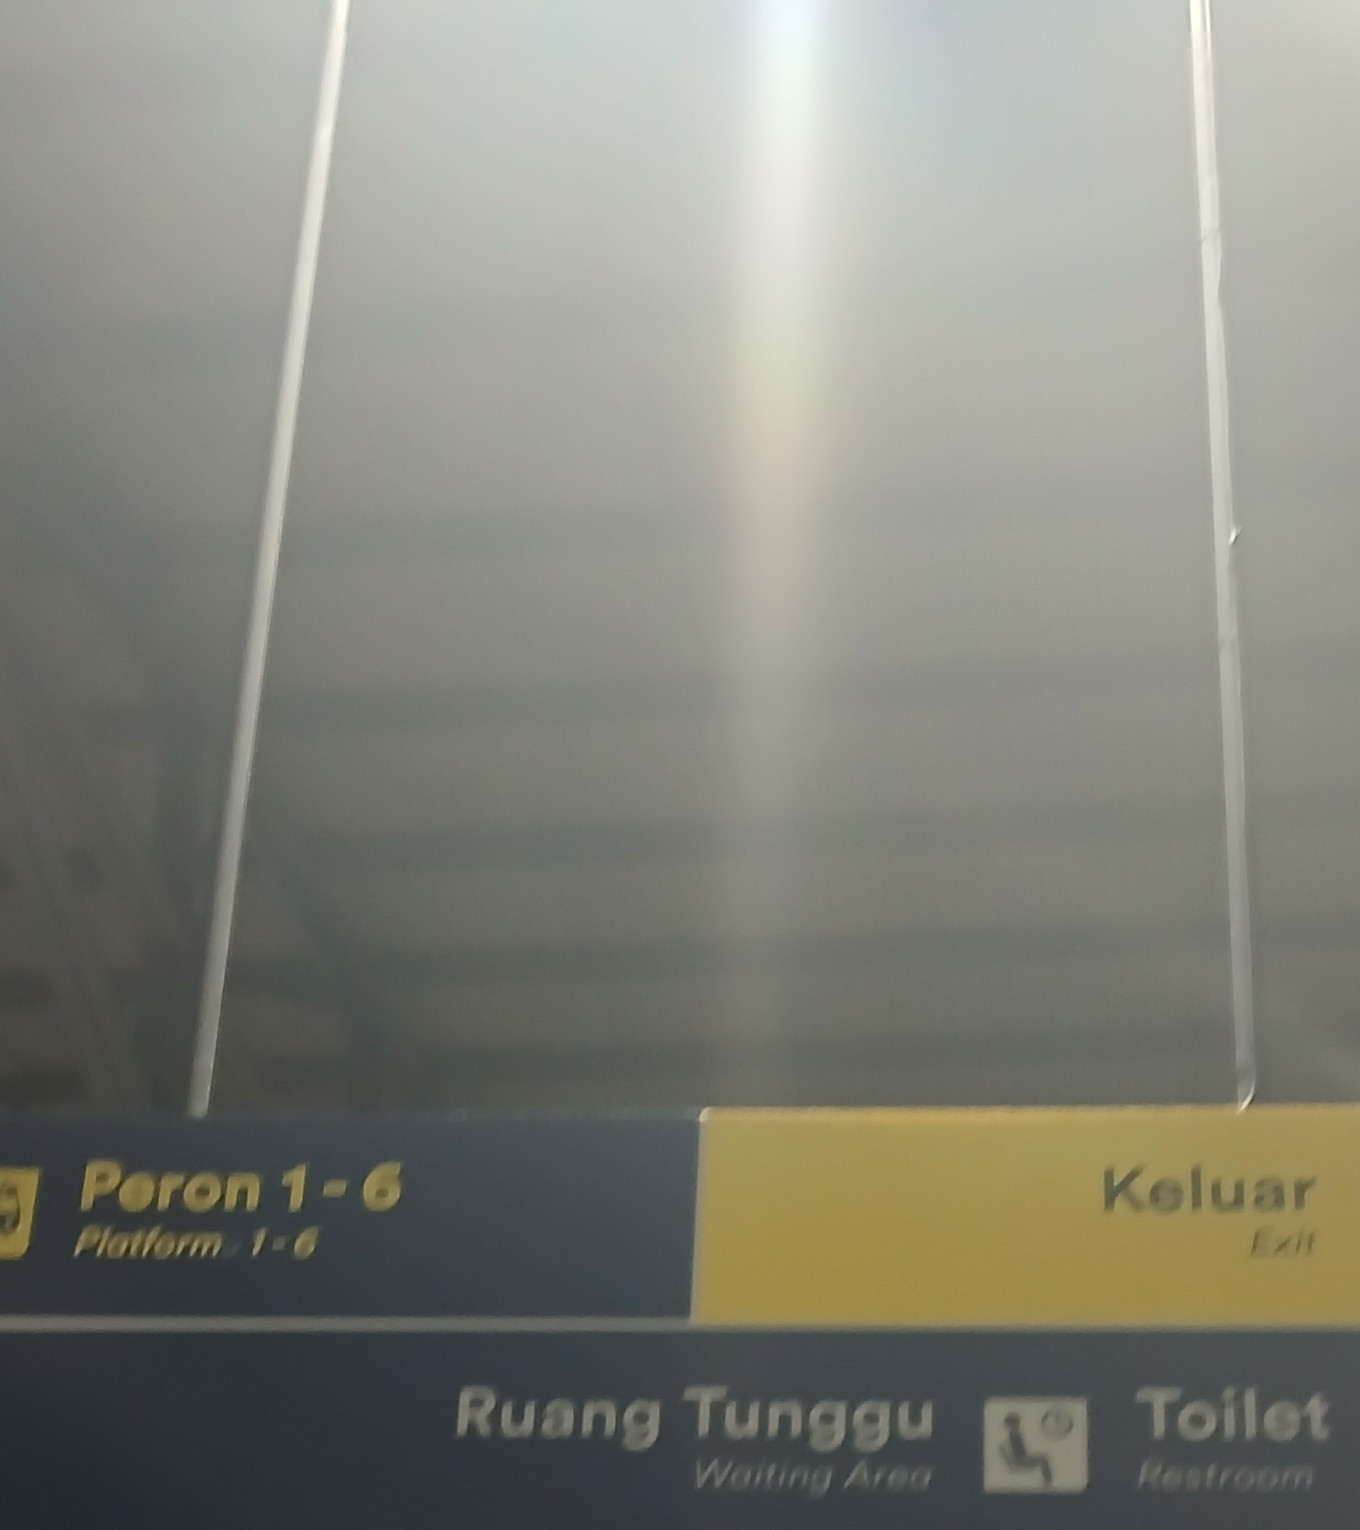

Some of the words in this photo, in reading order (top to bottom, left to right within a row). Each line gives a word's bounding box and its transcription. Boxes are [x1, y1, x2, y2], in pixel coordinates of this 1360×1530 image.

[81, 1159, 261, 1213] Peron
[1103, 1163, 1318, 1214] Keluar
[73, 1224, 224, 1259] Platform
[1249, 1225, 1318, 1259] Exit
[456, 1384, 661, 1451] Ruang
[682, 1384, 934, 1452] Tunggu
[1136, 1385, 1332, 1442] Toilet
[693, 1458, 833, 1497] Waiting
[843, 1458, 934, 1491] Area
[1138, 1456, 1314, 1493] Restroom
